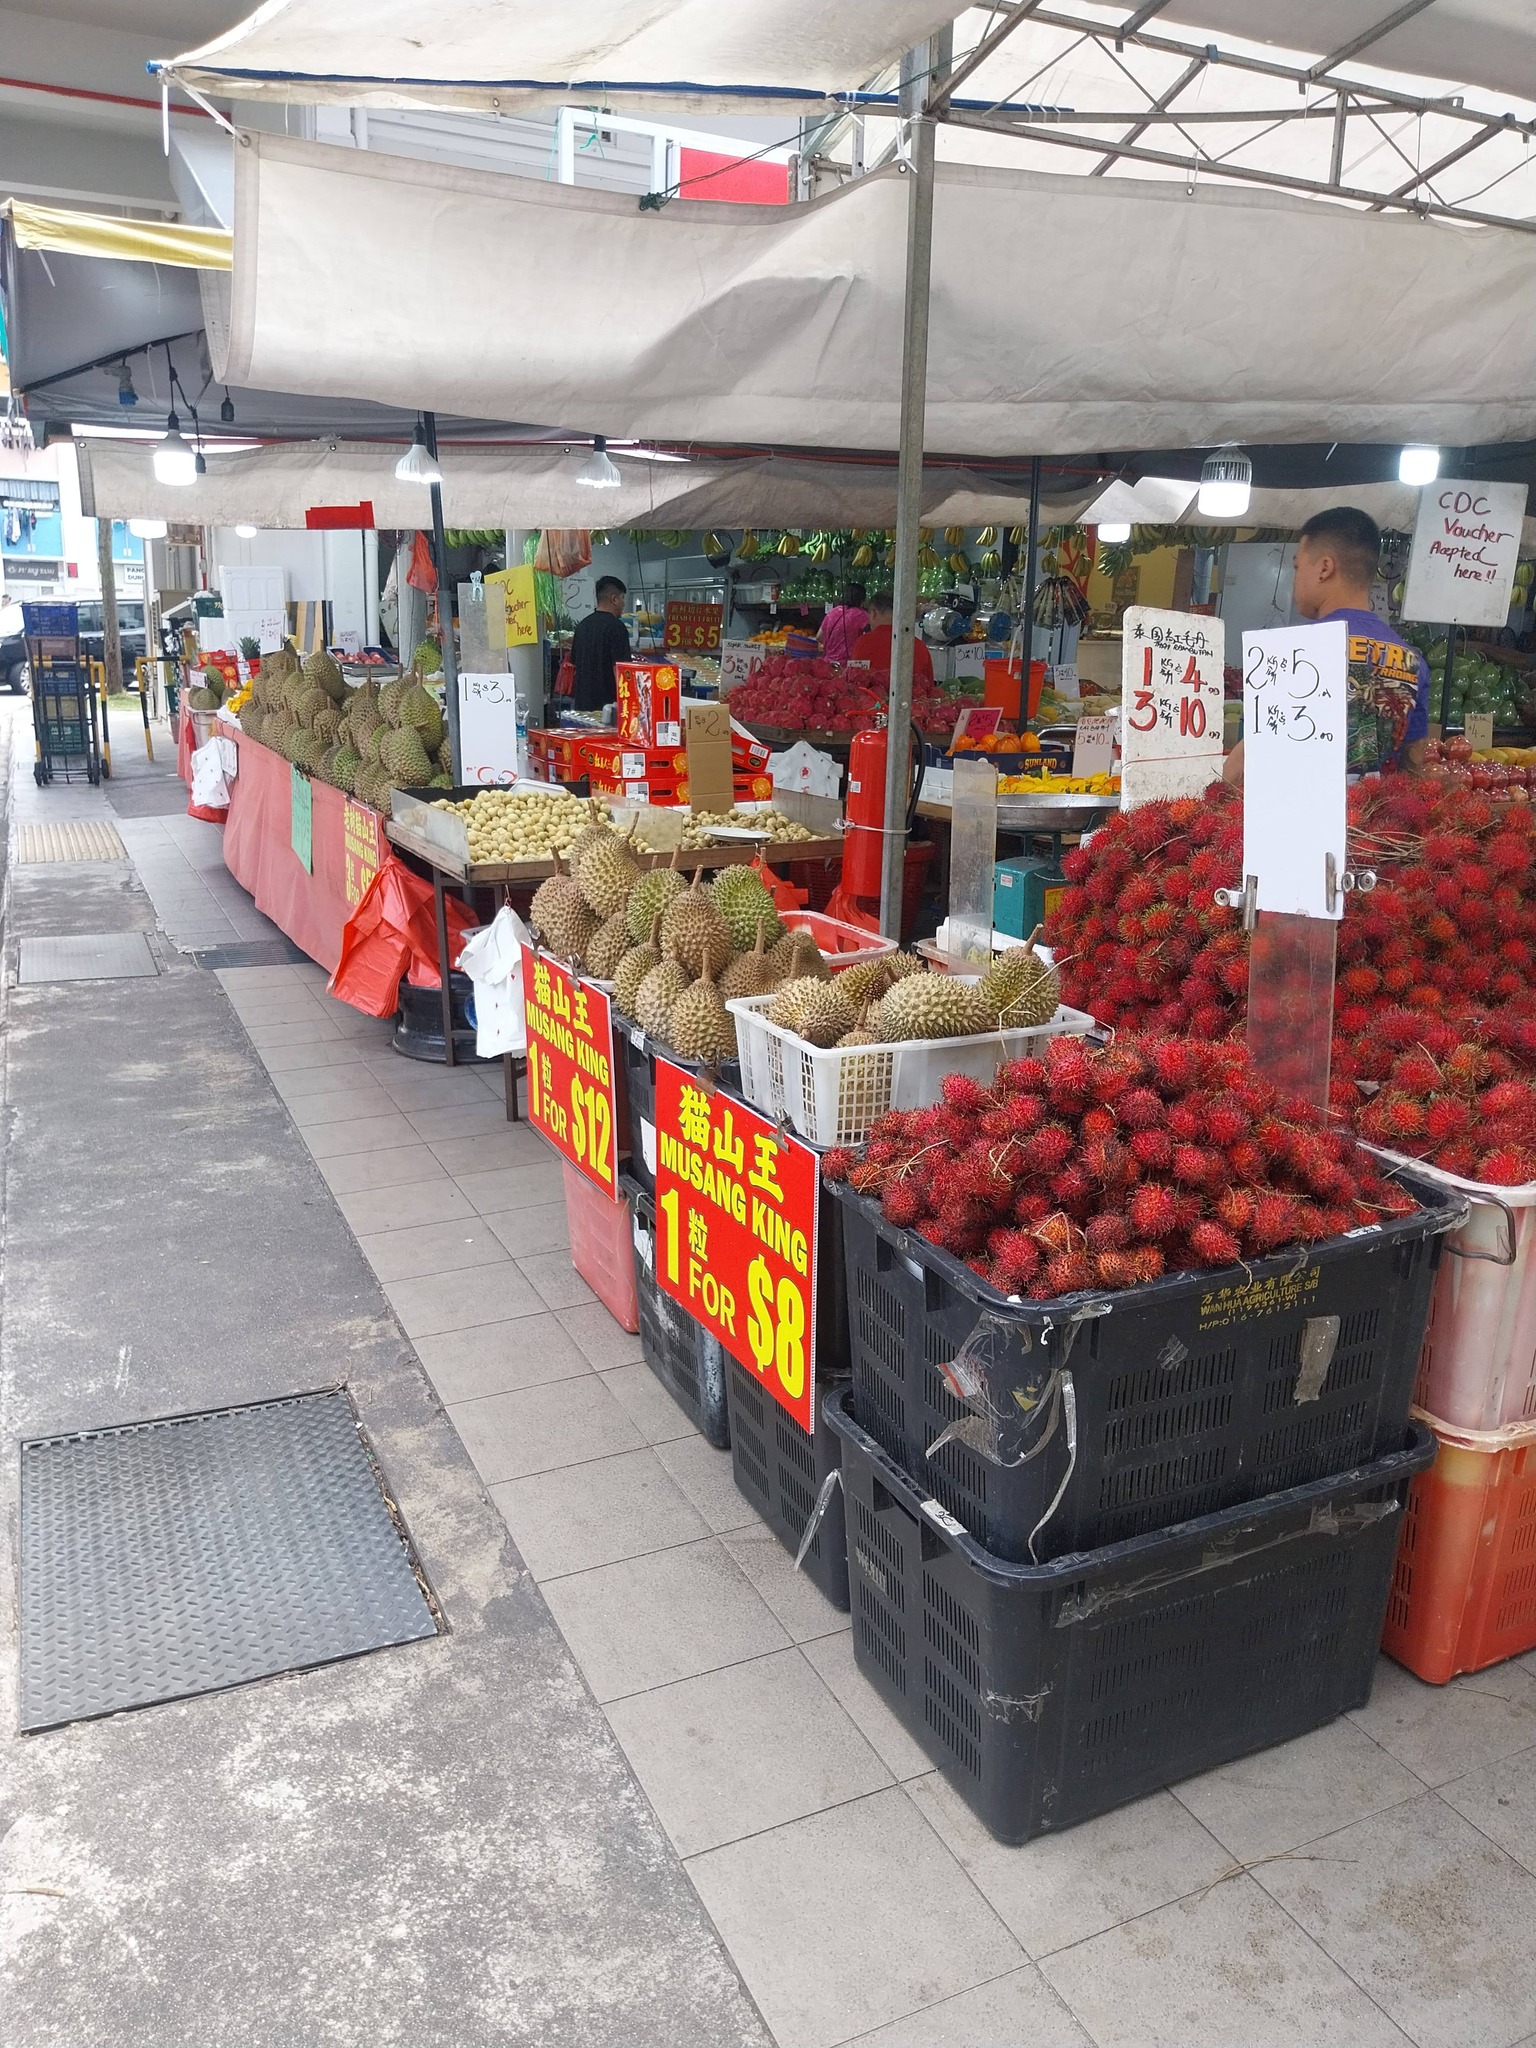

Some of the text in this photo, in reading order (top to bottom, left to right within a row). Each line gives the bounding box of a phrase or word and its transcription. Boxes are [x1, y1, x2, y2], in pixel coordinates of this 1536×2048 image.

[1438, 490, 1492, 516] CDC
[1443, 516, 1515, 544] Voucher
[667, 623, 681, 647] 3
[693, 626, 719, 648] $5
[722, 655, 735, 674] 3
[1143, 646, 1153, 686] 1
[1245, 646, 1268, 690] 2
[464, 677, 468, 701] 1
[688, 709, 692, 729] 1
[1128, 690, 1158, 732] 3
[1252, 695, 1262, 734] 1
[1077, 733, 1085, 745] 5
[1024, 758, 1057, 770] SUNLAND
[533, 961, 594, 1038] 猫山王
[526, 999, 610, 1088] MUSANG KING
[529, 1040, 612, 1184] 1 粒 FOR $12
[679, 1084, 784, 1203] 猫山王
[660, 1131, 809, 1277] MUSANG KING
[661, 1187, 805, 1400] 1 粒 FOR $8
[1200, 1279, 1319, 1317] WAN HUA AGRICULTURE S/B
